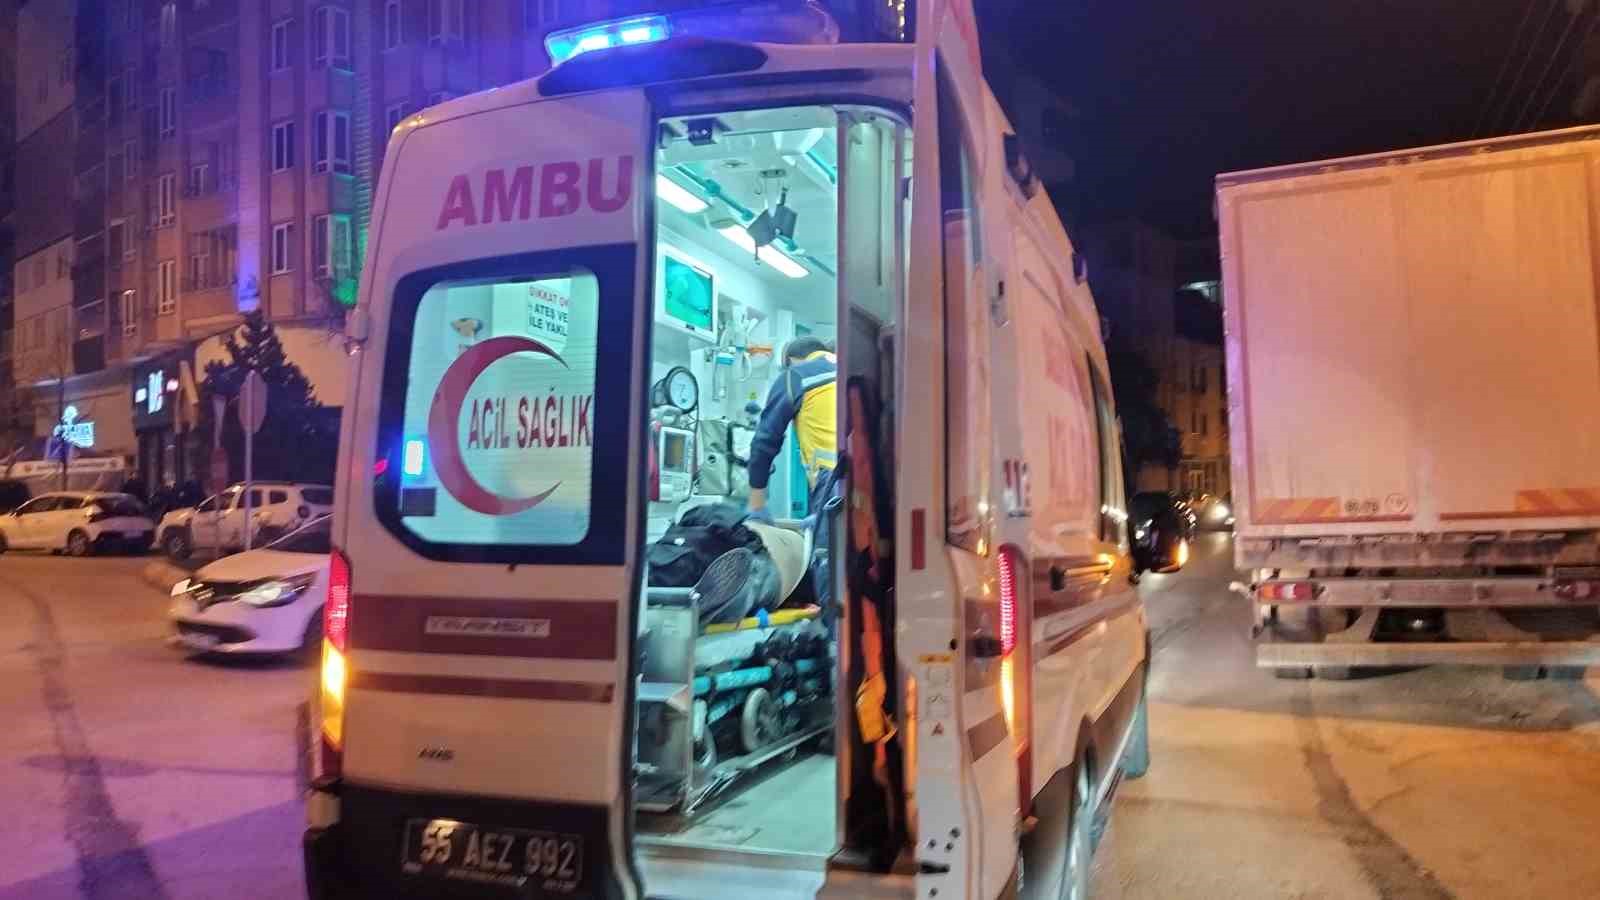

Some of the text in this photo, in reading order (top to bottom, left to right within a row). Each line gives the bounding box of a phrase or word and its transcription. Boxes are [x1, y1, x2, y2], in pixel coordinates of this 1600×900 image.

[436, 155, 634, 230] AMBU
[420, 822, 453, 864] 55
[464, 829, 515, 871] AEZ
[526, 836, 577, 879] 992
